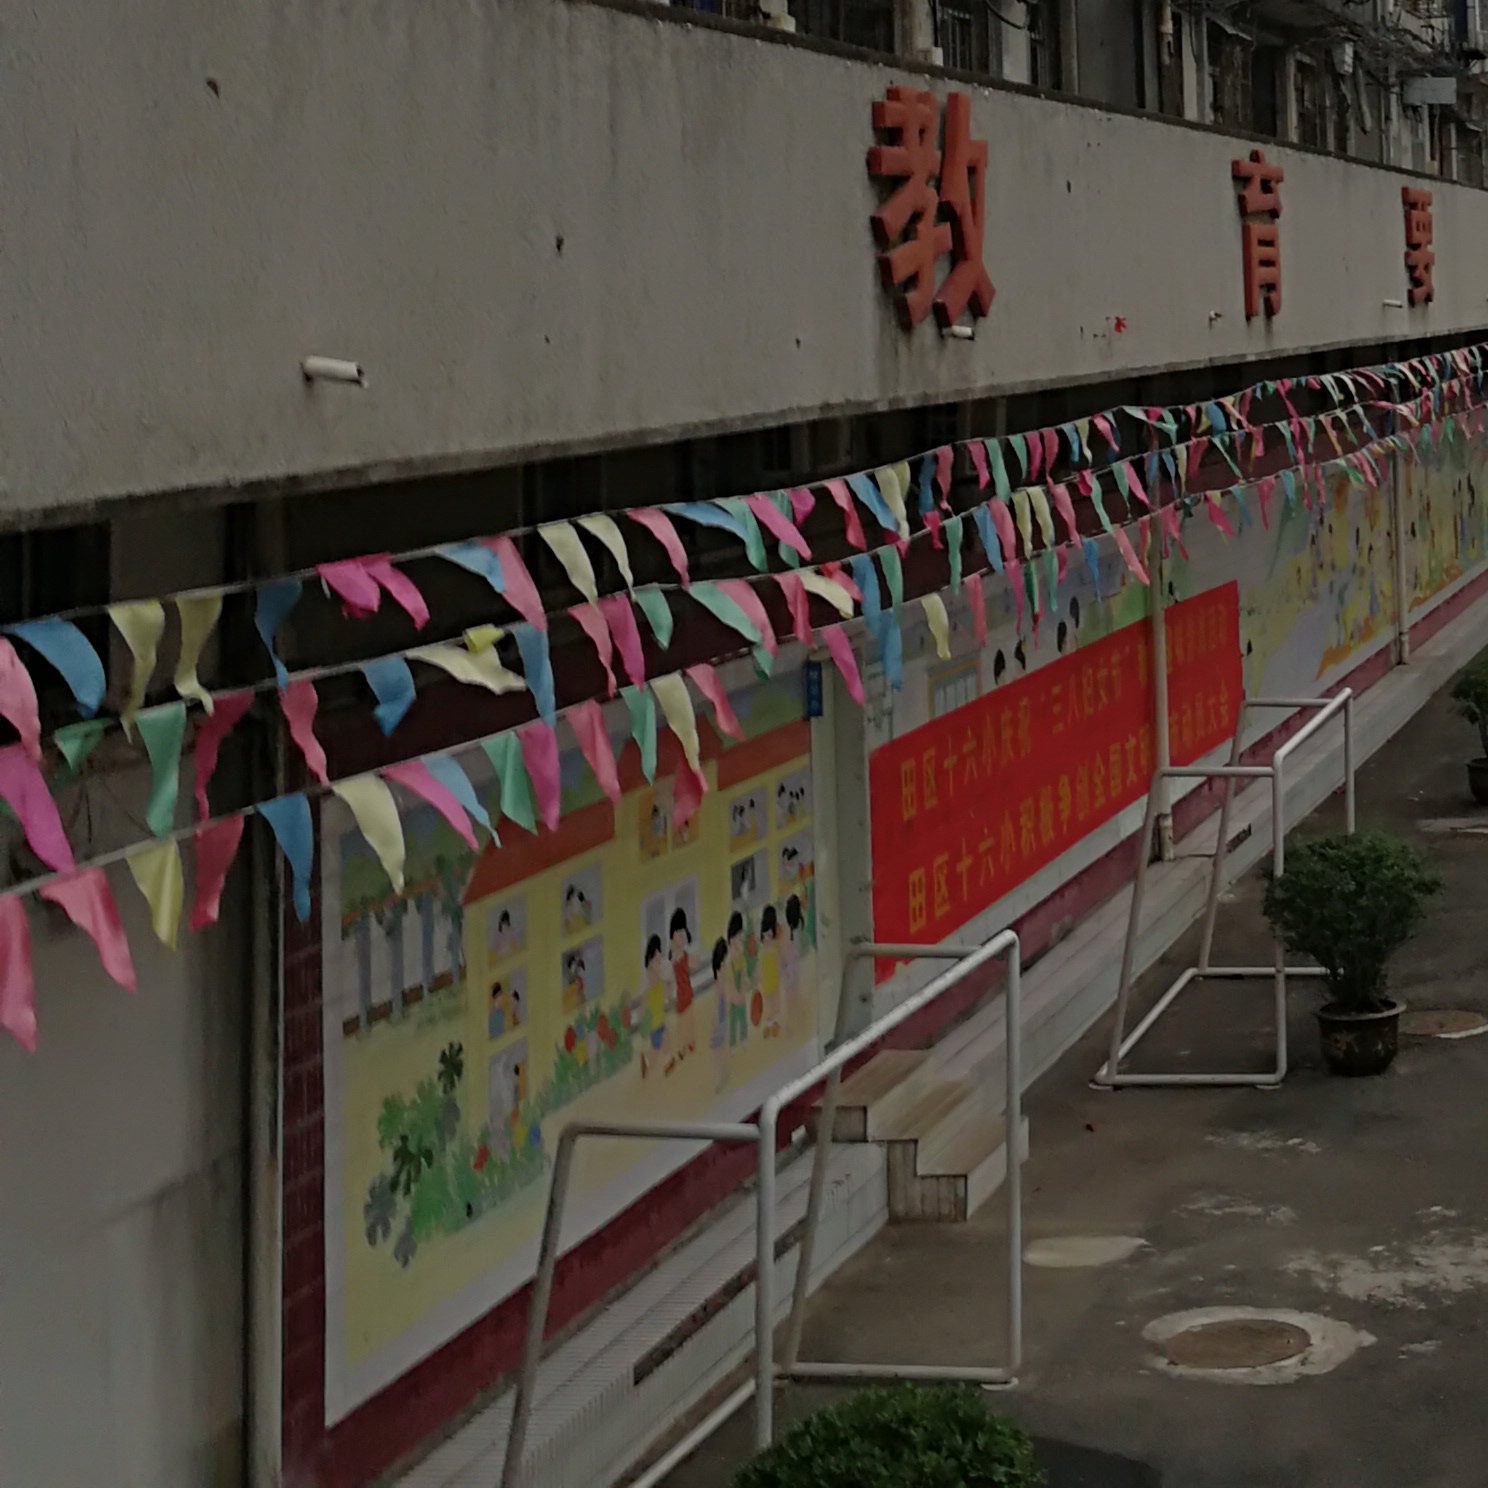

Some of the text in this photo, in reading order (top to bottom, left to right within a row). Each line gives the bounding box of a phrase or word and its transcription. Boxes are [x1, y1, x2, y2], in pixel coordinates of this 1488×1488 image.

[908, 685, 1230, 935] 田区十六小积极争创全国文明市动员大会
